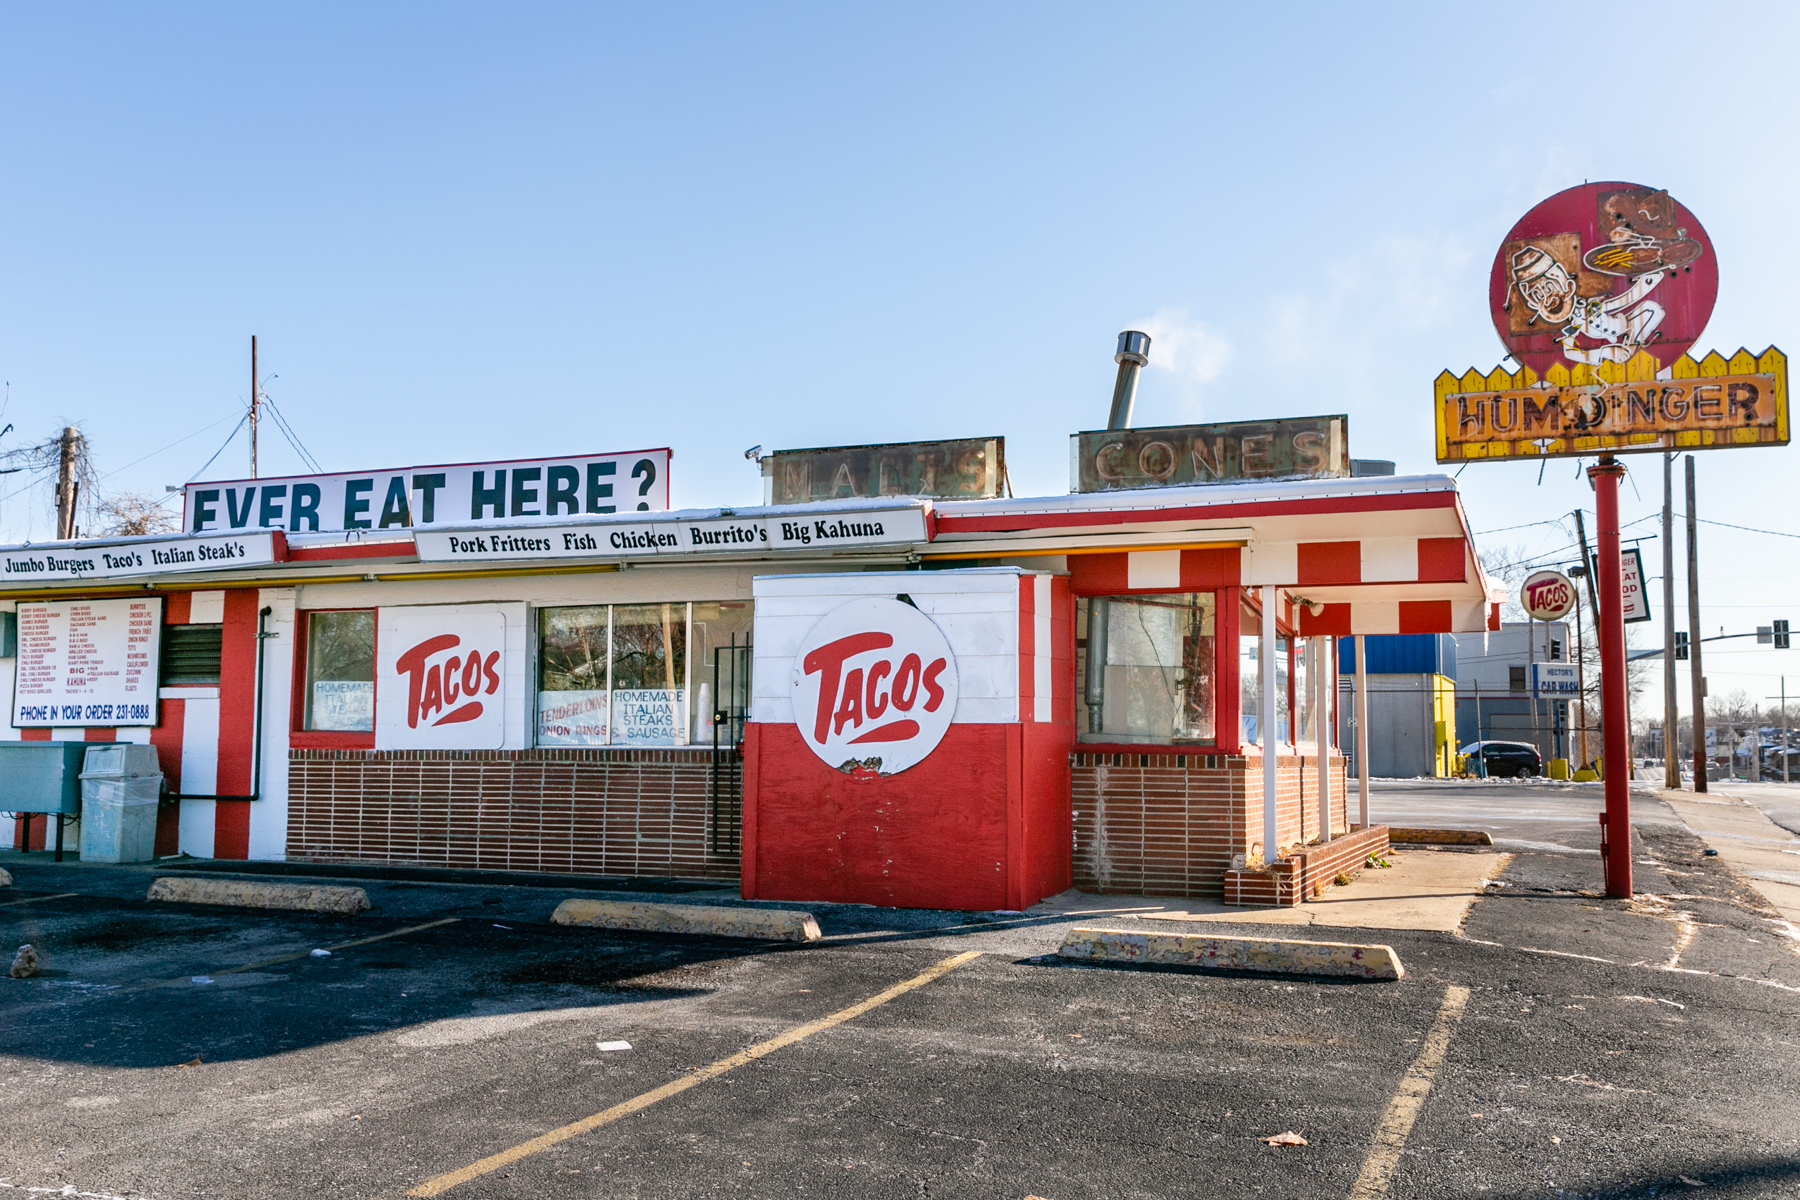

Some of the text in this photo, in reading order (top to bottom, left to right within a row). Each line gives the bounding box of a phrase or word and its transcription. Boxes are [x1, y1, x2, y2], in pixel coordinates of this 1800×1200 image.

[1096, 431, 1327, 480] CONES
[785, 452, 986, 497] MALTS
[193, 483, 321, 531] EVER
[344, 473, 446, 530] EAT
[449, 520, 885, 553] Pork Fritters Fish Chicken Burrito's Big Kahuna
[5, 542, 245, 574] Jumbo Burgers Taco's Italian Steak's
[1526, 578, 1569, 612] TACOS
[67, 678, 86, 686] KAHUNA
[396, 634, 500, 729] TACOS
[1547, 668, 1573, 676] HECTOR'S
[615, 691, 683, 702] HOMEMADE
[803, 631, 947, 745] TACOS
[1541, 681, 1579, 694] CAR WASH
[20, 704, 149, 720] PHONE IN YOUR ORDER 231-0888
[540, 694, 607, 724] TENDERLOINS
[624, 704, 673, 714] ITALIAN
[624, 715, 673, 725] STEAKS
[540, 725, 607, 736] ONION RINGS
[627, 728, 685, 738] SAUSAGE
